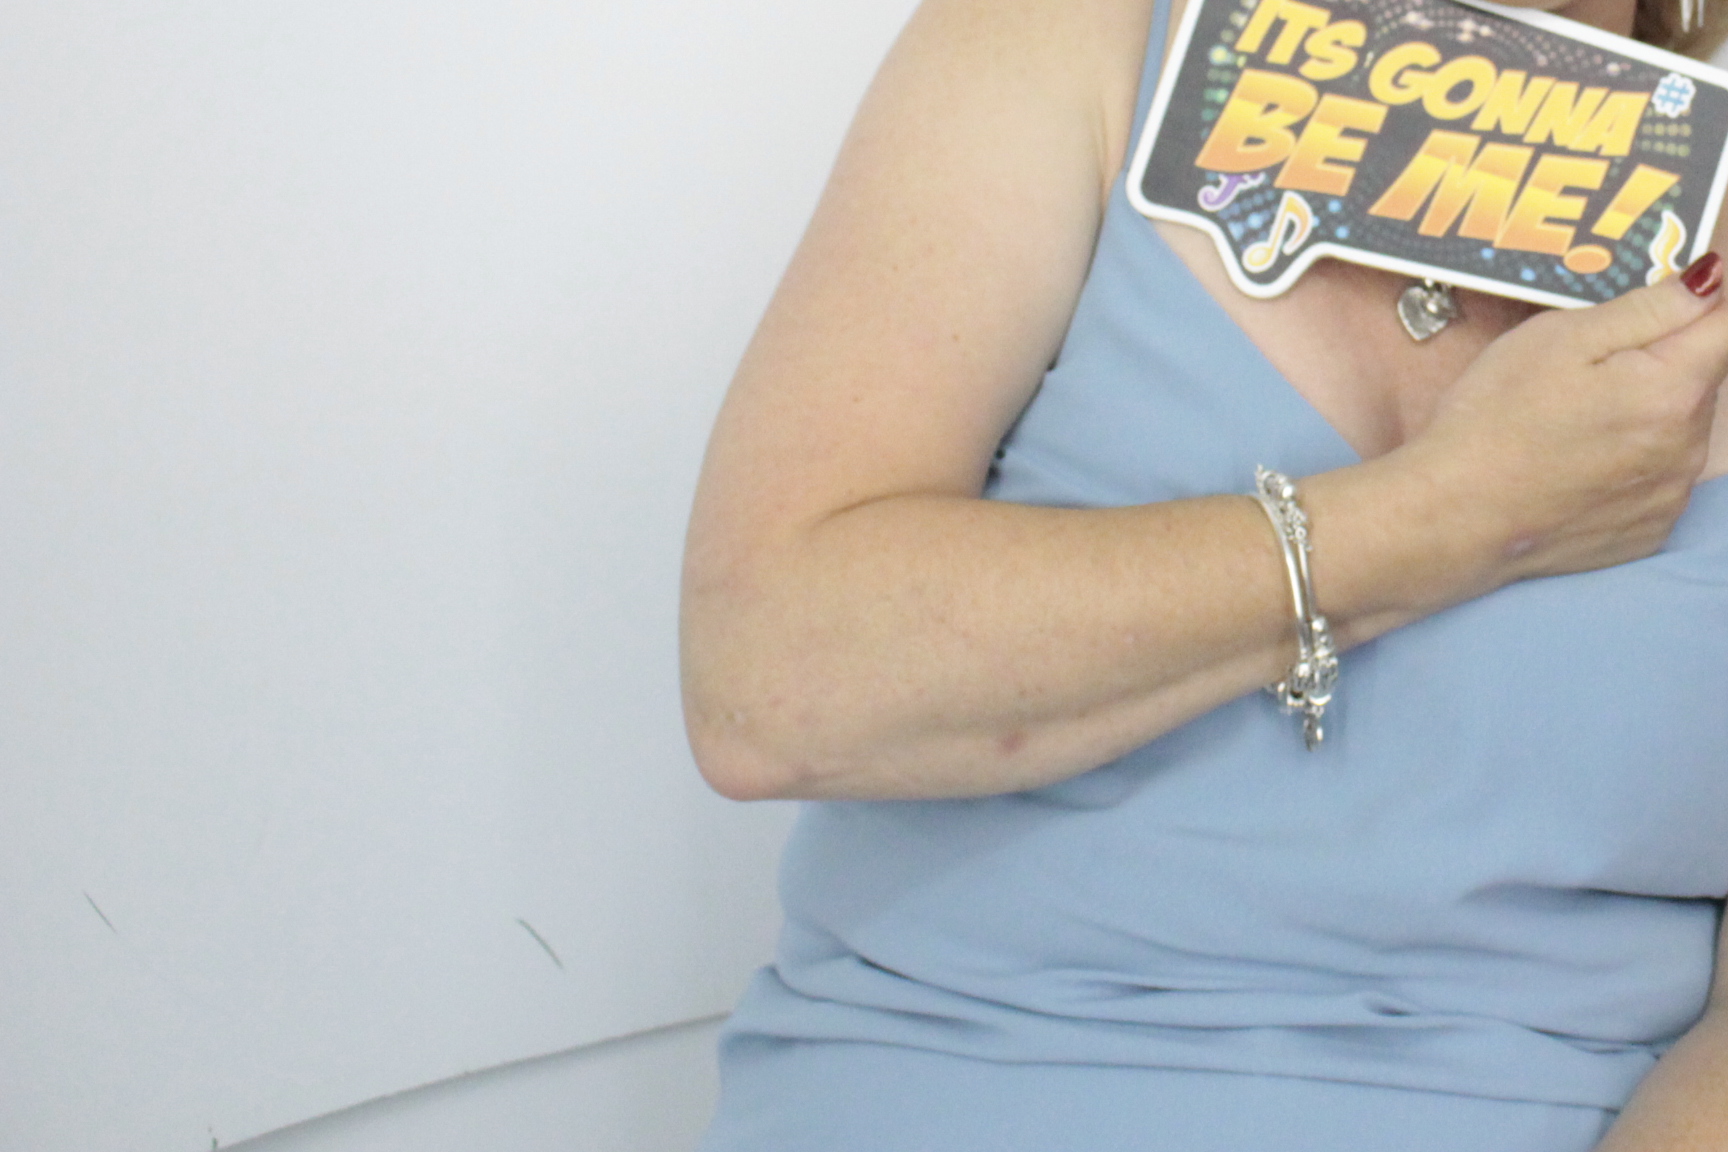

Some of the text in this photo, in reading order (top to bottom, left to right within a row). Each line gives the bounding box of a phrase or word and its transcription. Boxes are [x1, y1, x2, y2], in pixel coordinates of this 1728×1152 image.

[1195, 69, 1680, 274] BE ME!
[1368, 42, 1652, 156] GONNA
